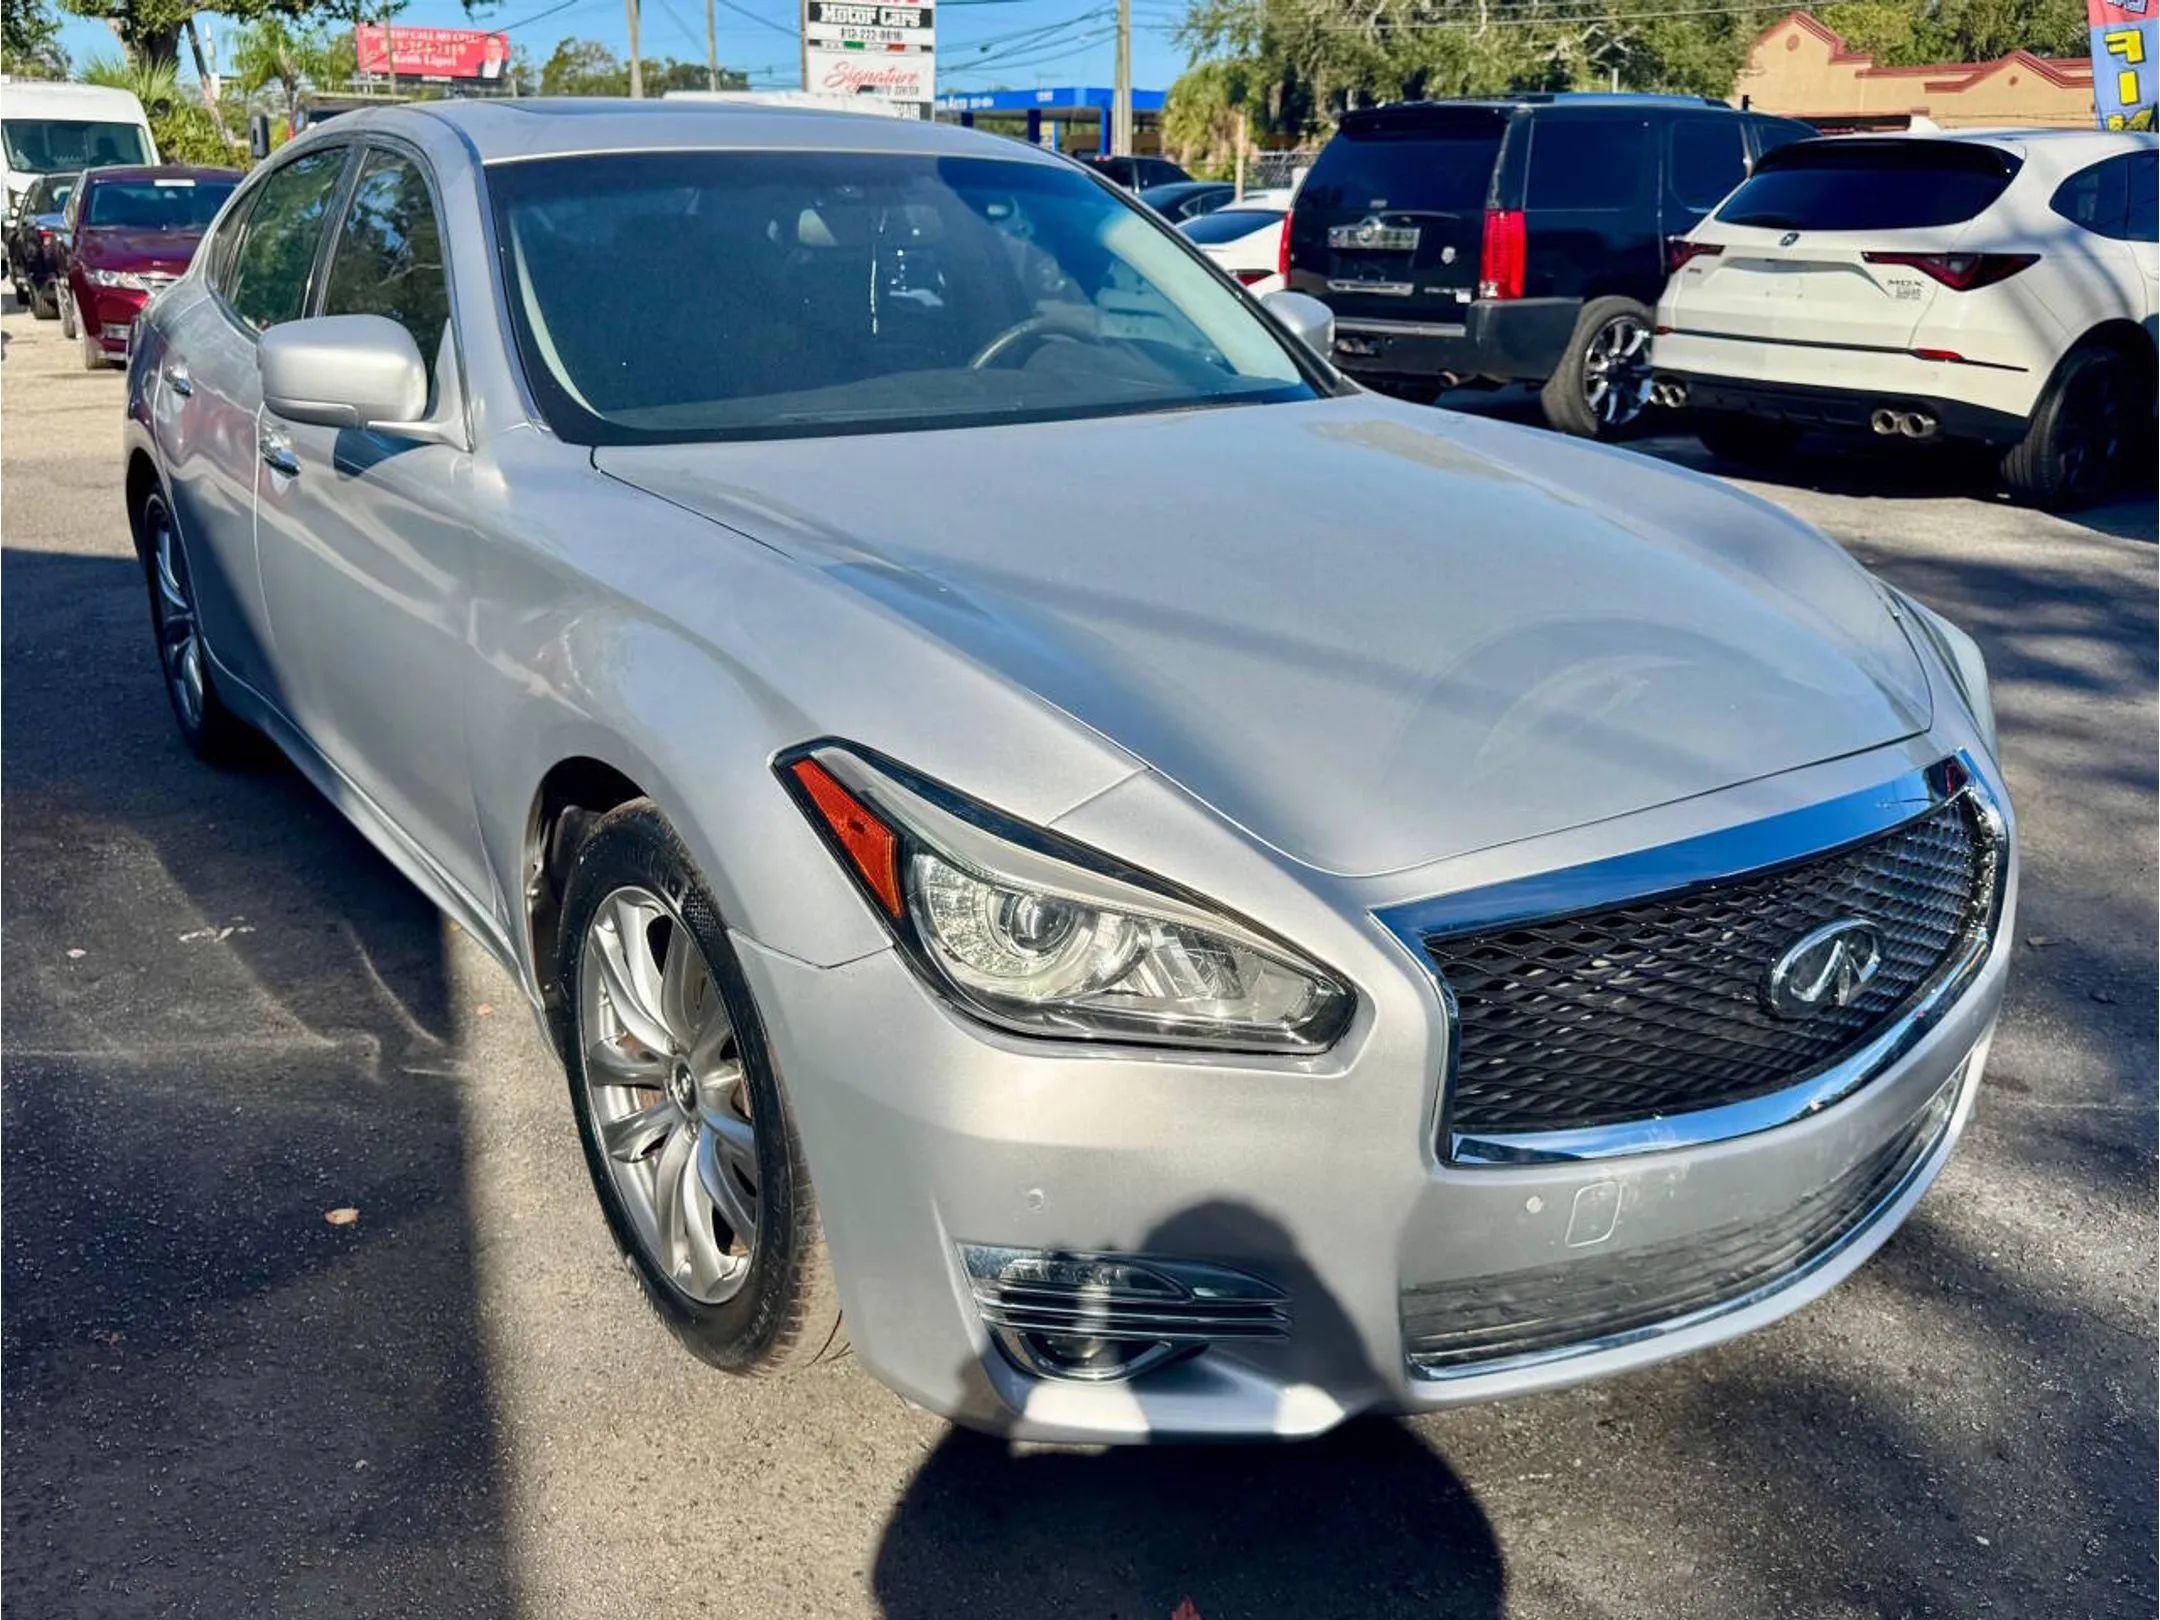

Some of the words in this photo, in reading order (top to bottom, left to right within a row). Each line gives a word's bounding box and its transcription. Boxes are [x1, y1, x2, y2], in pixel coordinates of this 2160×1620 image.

[820, 3, 877, 26] Motor
[880, 6, 920, 28] Cars
[824, 61, 918, 93] Signature
